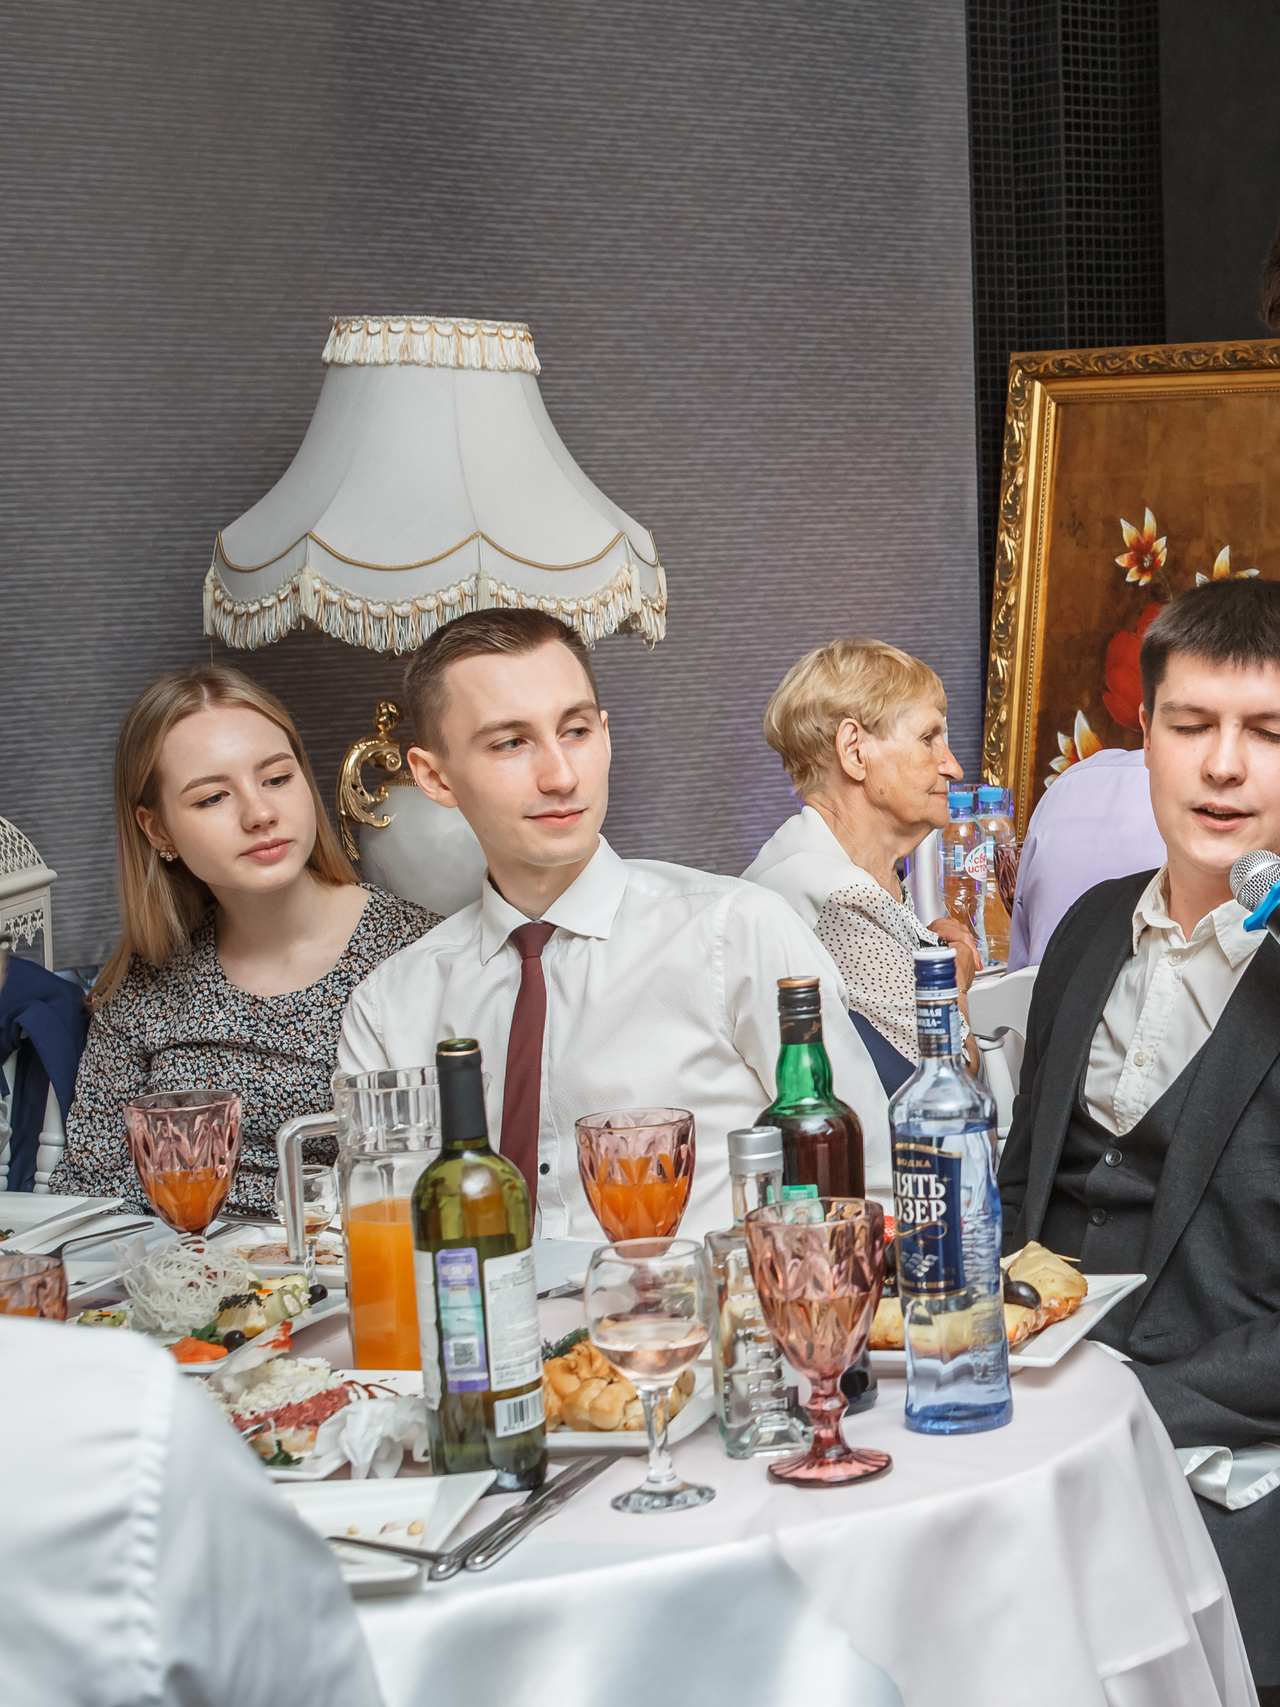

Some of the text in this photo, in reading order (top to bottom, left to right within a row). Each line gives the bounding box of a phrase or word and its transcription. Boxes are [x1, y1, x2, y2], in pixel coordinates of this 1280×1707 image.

[896, 1156, 932, 1168] ВОДКА
[894, 1171, 946, 1199] ПЯТЬ
[894, 1197, 947, 1224] ОЗЕР
